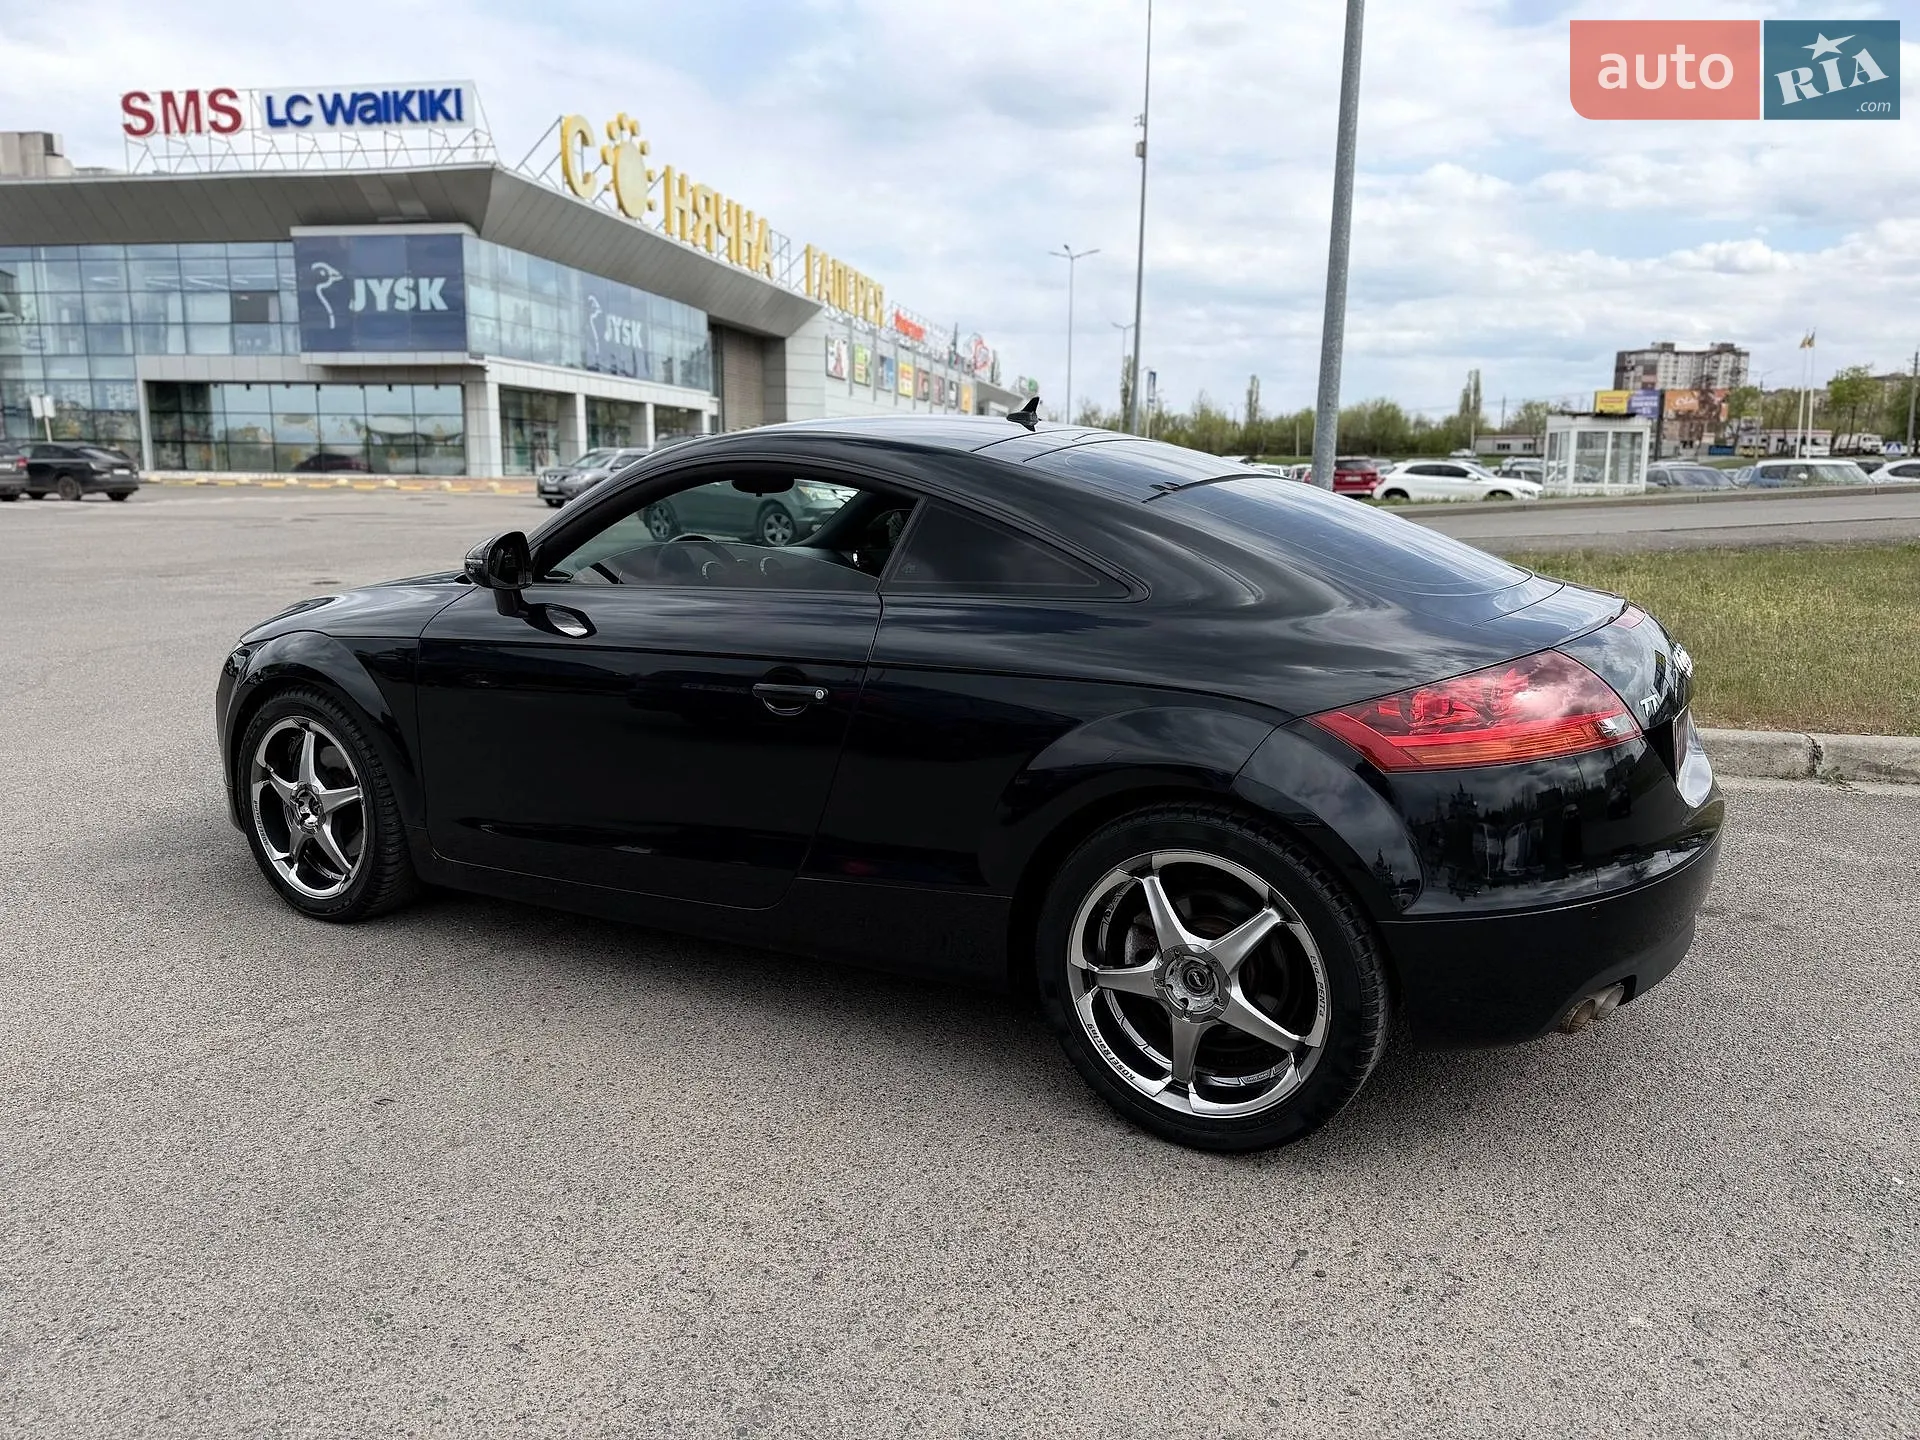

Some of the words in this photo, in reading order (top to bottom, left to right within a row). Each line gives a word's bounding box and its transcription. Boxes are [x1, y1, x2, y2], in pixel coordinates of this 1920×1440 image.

[121, 87, 244, 137] SMS
[266, 94, 313, 128] LC
[349, 277, 448, 311] JYSK
[604, 315, 643, 349] JYSK
